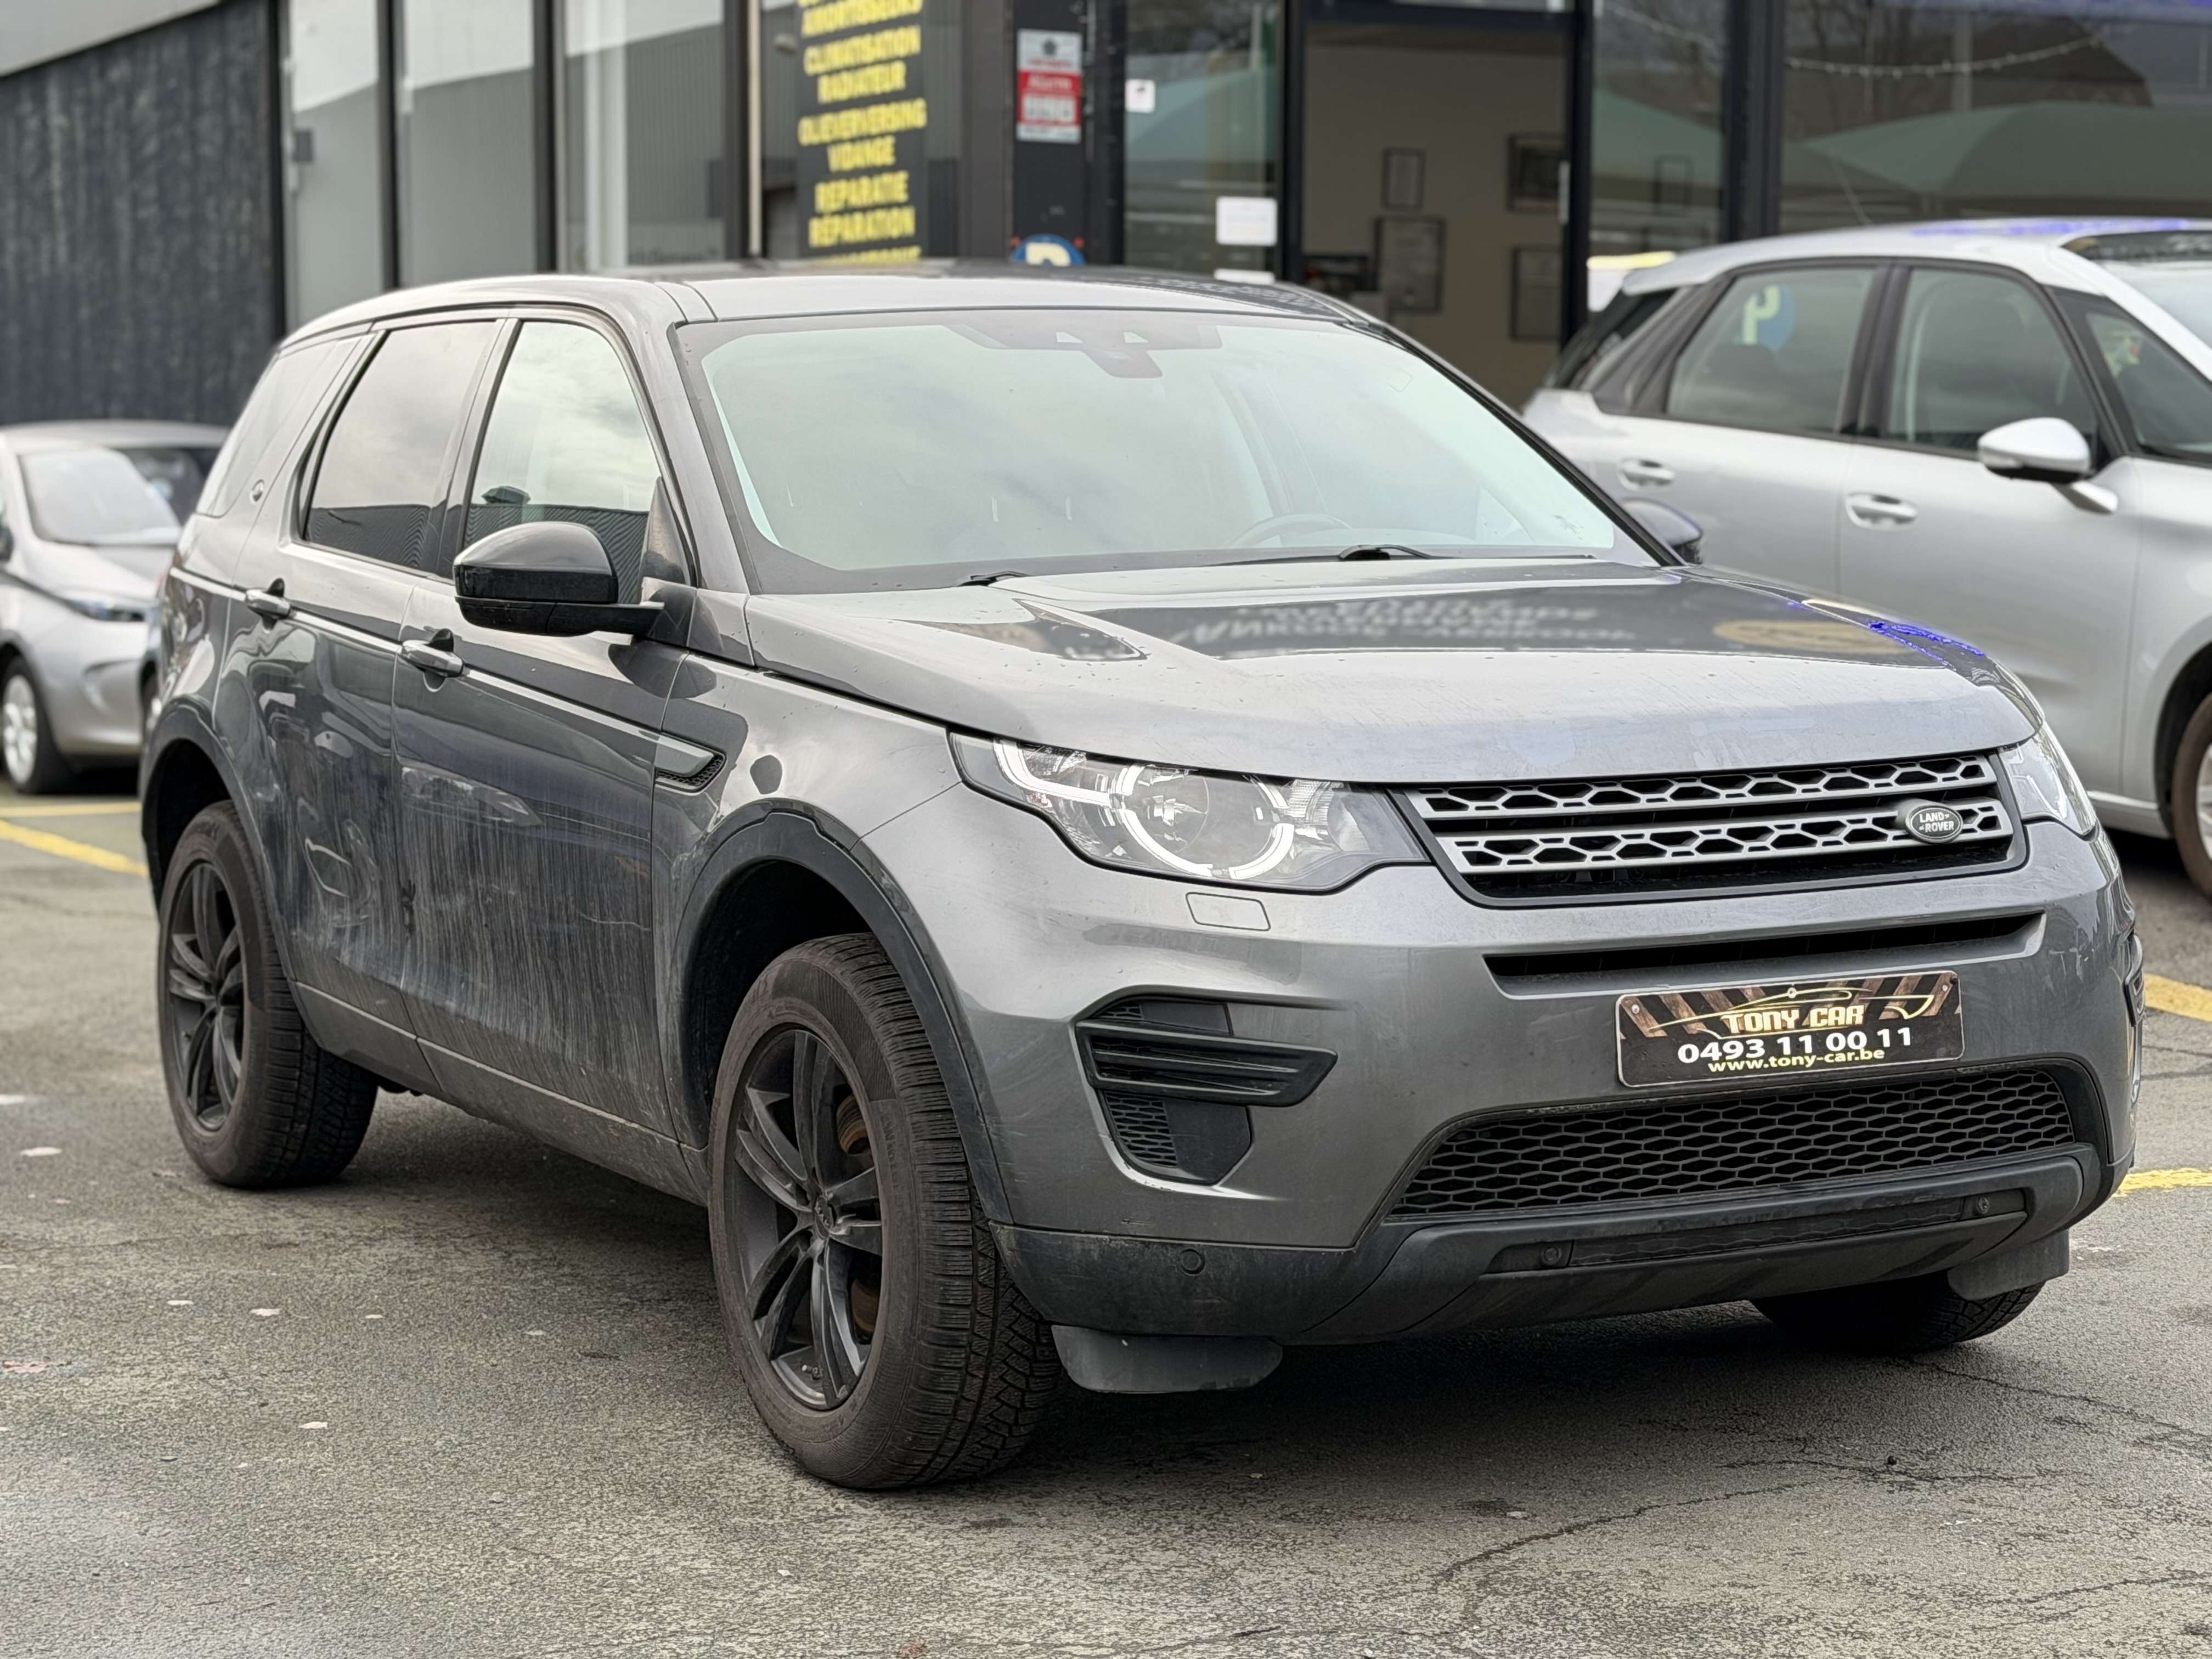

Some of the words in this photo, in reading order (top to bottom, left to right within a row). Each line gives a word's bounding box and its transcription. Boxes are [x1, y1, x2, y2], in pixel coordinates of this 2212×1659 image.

[827, 135, 896, 172] VIDANGE
[815, 170, 909, 213] REPARATIE
[1919, 812, 1945, 823] LAND
[1925, 821, 1954, 833] ROVER
[1721, 1008, 1800, 1034] TONY
[1810, 1005, 1864, 1028] CAR
[1677, 1039, 1766, 1064] 0493
[1776, 1036, 1813, 1055] 11
[1825, 1031, 1867, 1052] 00
[1876, 1027, 1911, 1048] 11
[1707, 1048, 1886, 1073] www.tony-car.be
